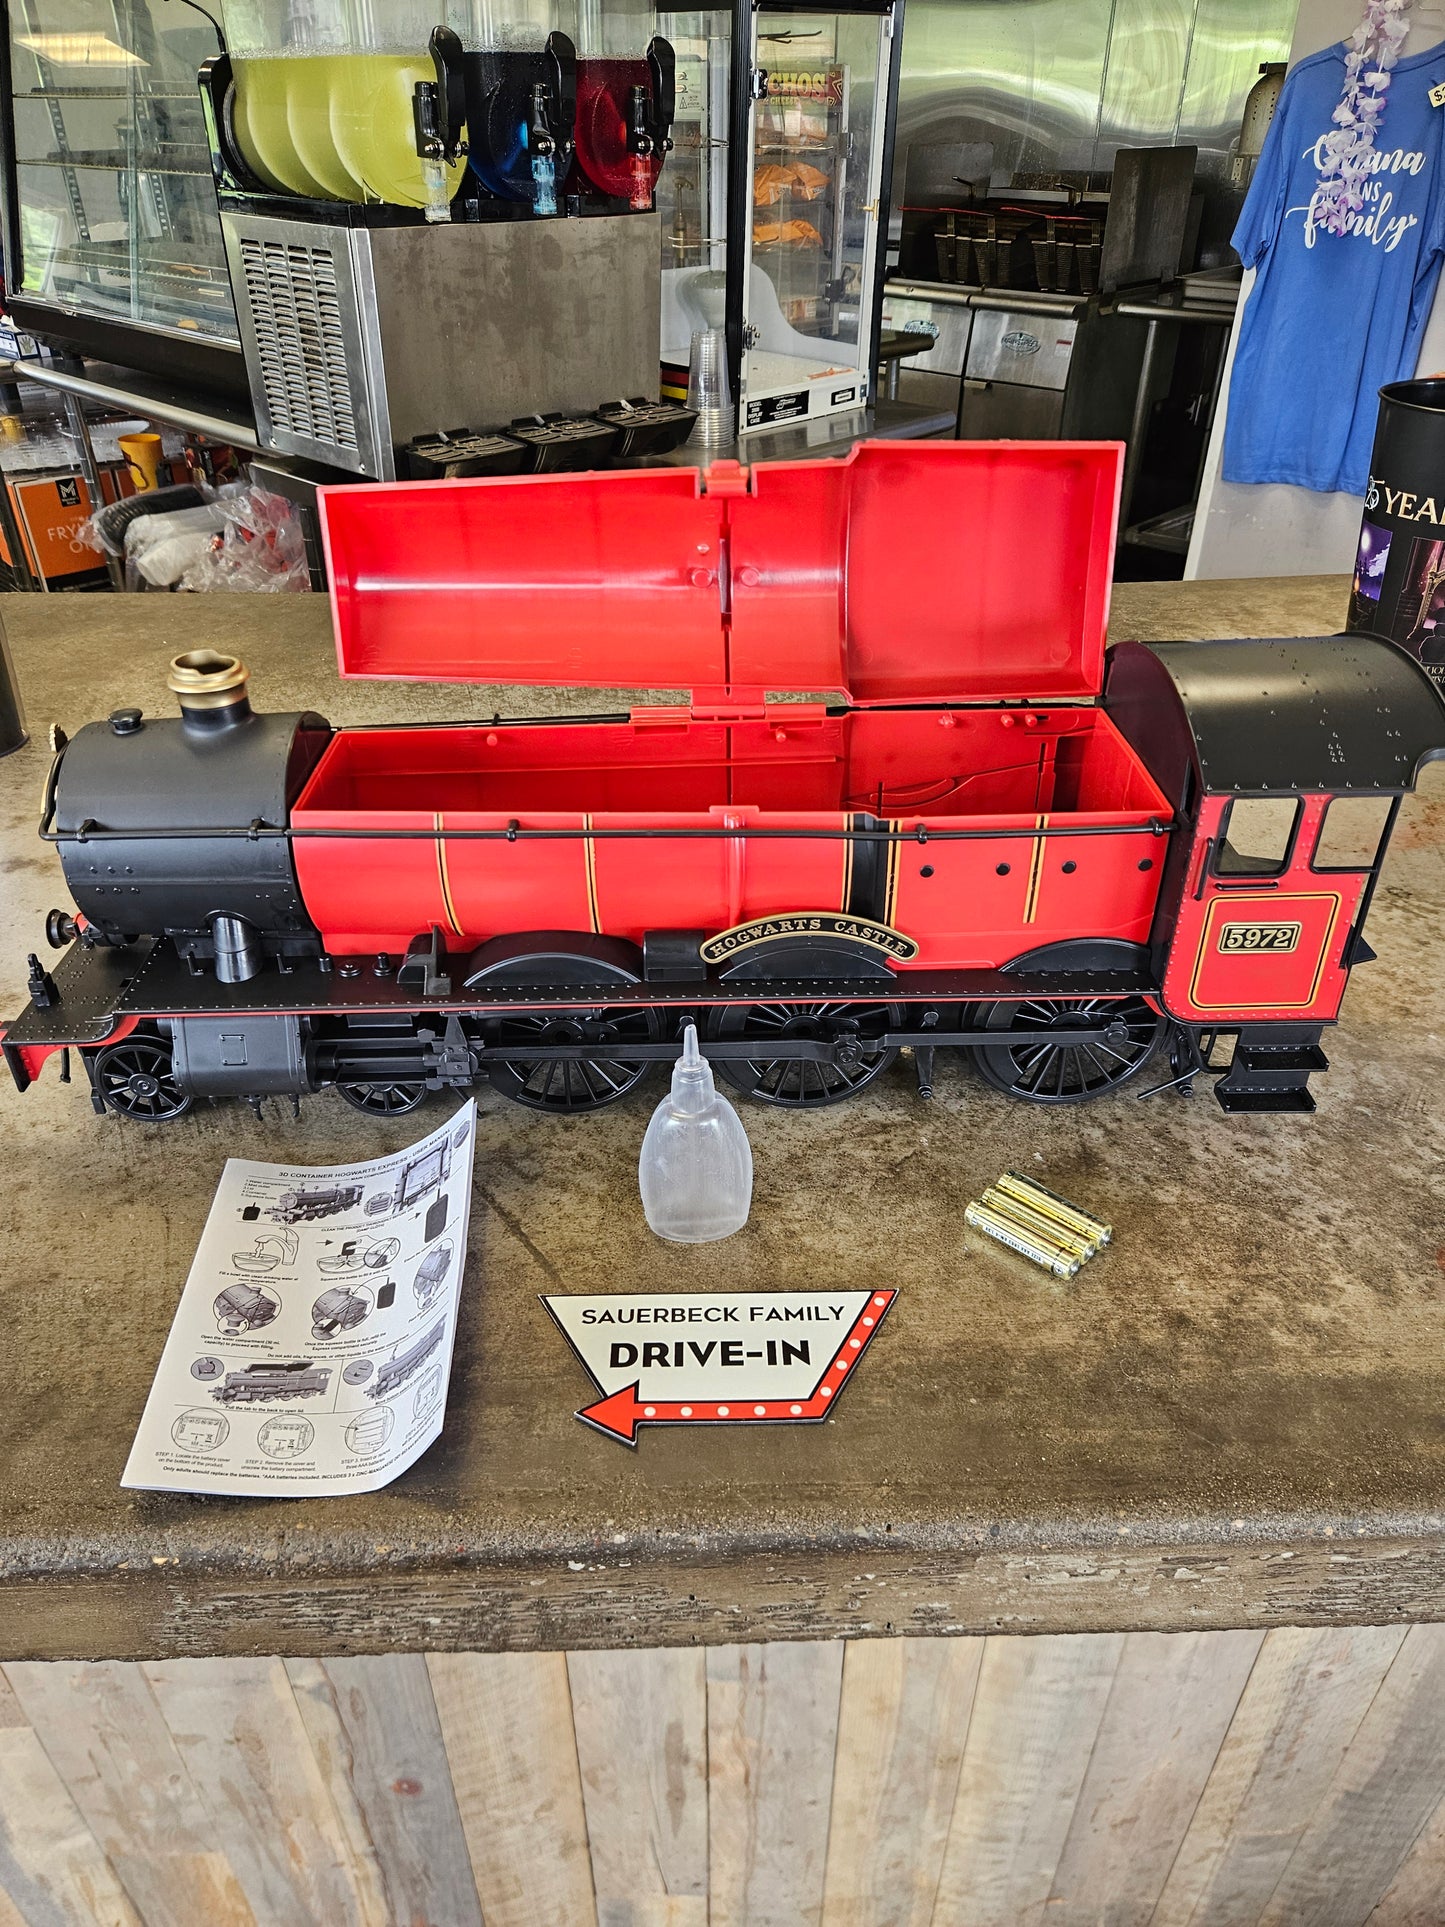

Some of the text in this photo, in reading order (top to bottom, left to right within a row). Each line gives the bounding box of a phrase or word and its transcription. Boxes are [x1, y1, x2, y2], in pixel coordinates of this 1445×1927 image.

[767, 72, 826, 100] CHOS
[1302, 130, 1426, 176] Oana
[709, 919, 908, 957] HOGWARTS CASTLE
[1226, 928, 1292, 948] 5972
[334, 1167, 376, 1178] HOGWARTS
[377, 1155, 408, 1170] EXPRESS
[412, 1146, 428, 1157] USER
[429, 1129, 450, 1147] MANUAL
[581, 1305, 845, 1325] SAUERBECK FAMILY
[609, 1339, 812, 1369] DRIVE-IN
